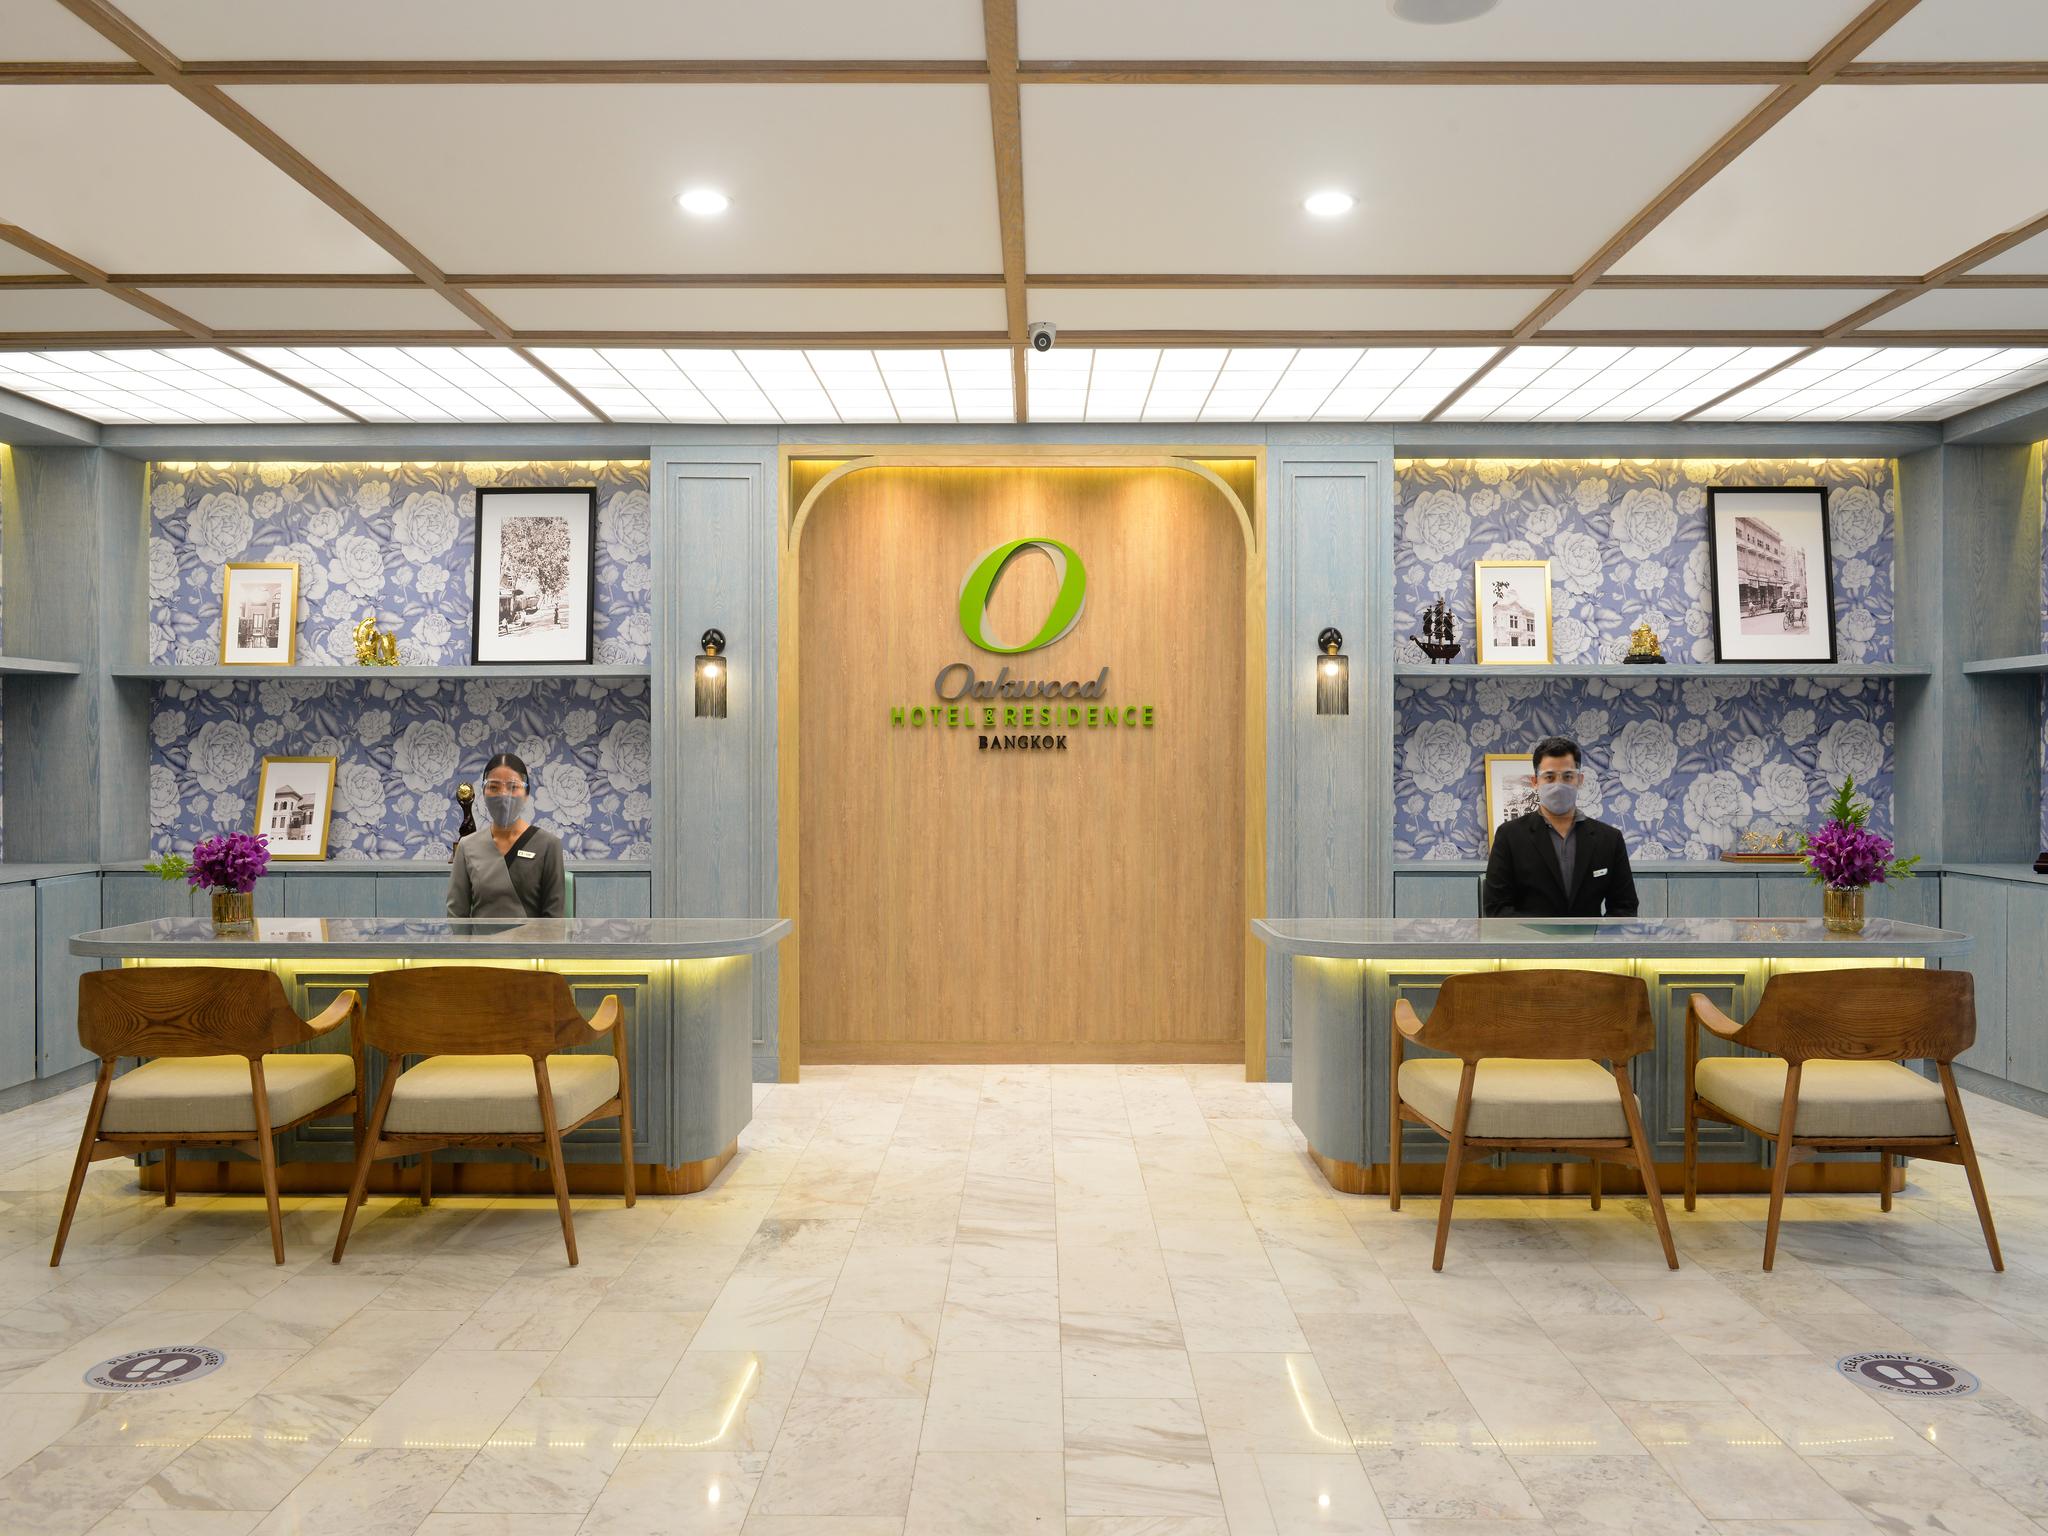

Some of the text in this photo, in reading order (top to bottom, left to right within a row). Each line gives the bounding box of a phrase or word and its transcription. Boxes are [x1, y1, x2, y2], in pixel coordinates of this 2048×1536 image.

[935, 662, 1109, 701] Oakwood
[891, 704, 1155, 727] HOTEL & RESIDENCE
[978, 734, 1067, 750] BANGKOK
[107, 1349, 167, 1365] PLEASE
[1917, 1358, 1959, 1372] HERE
